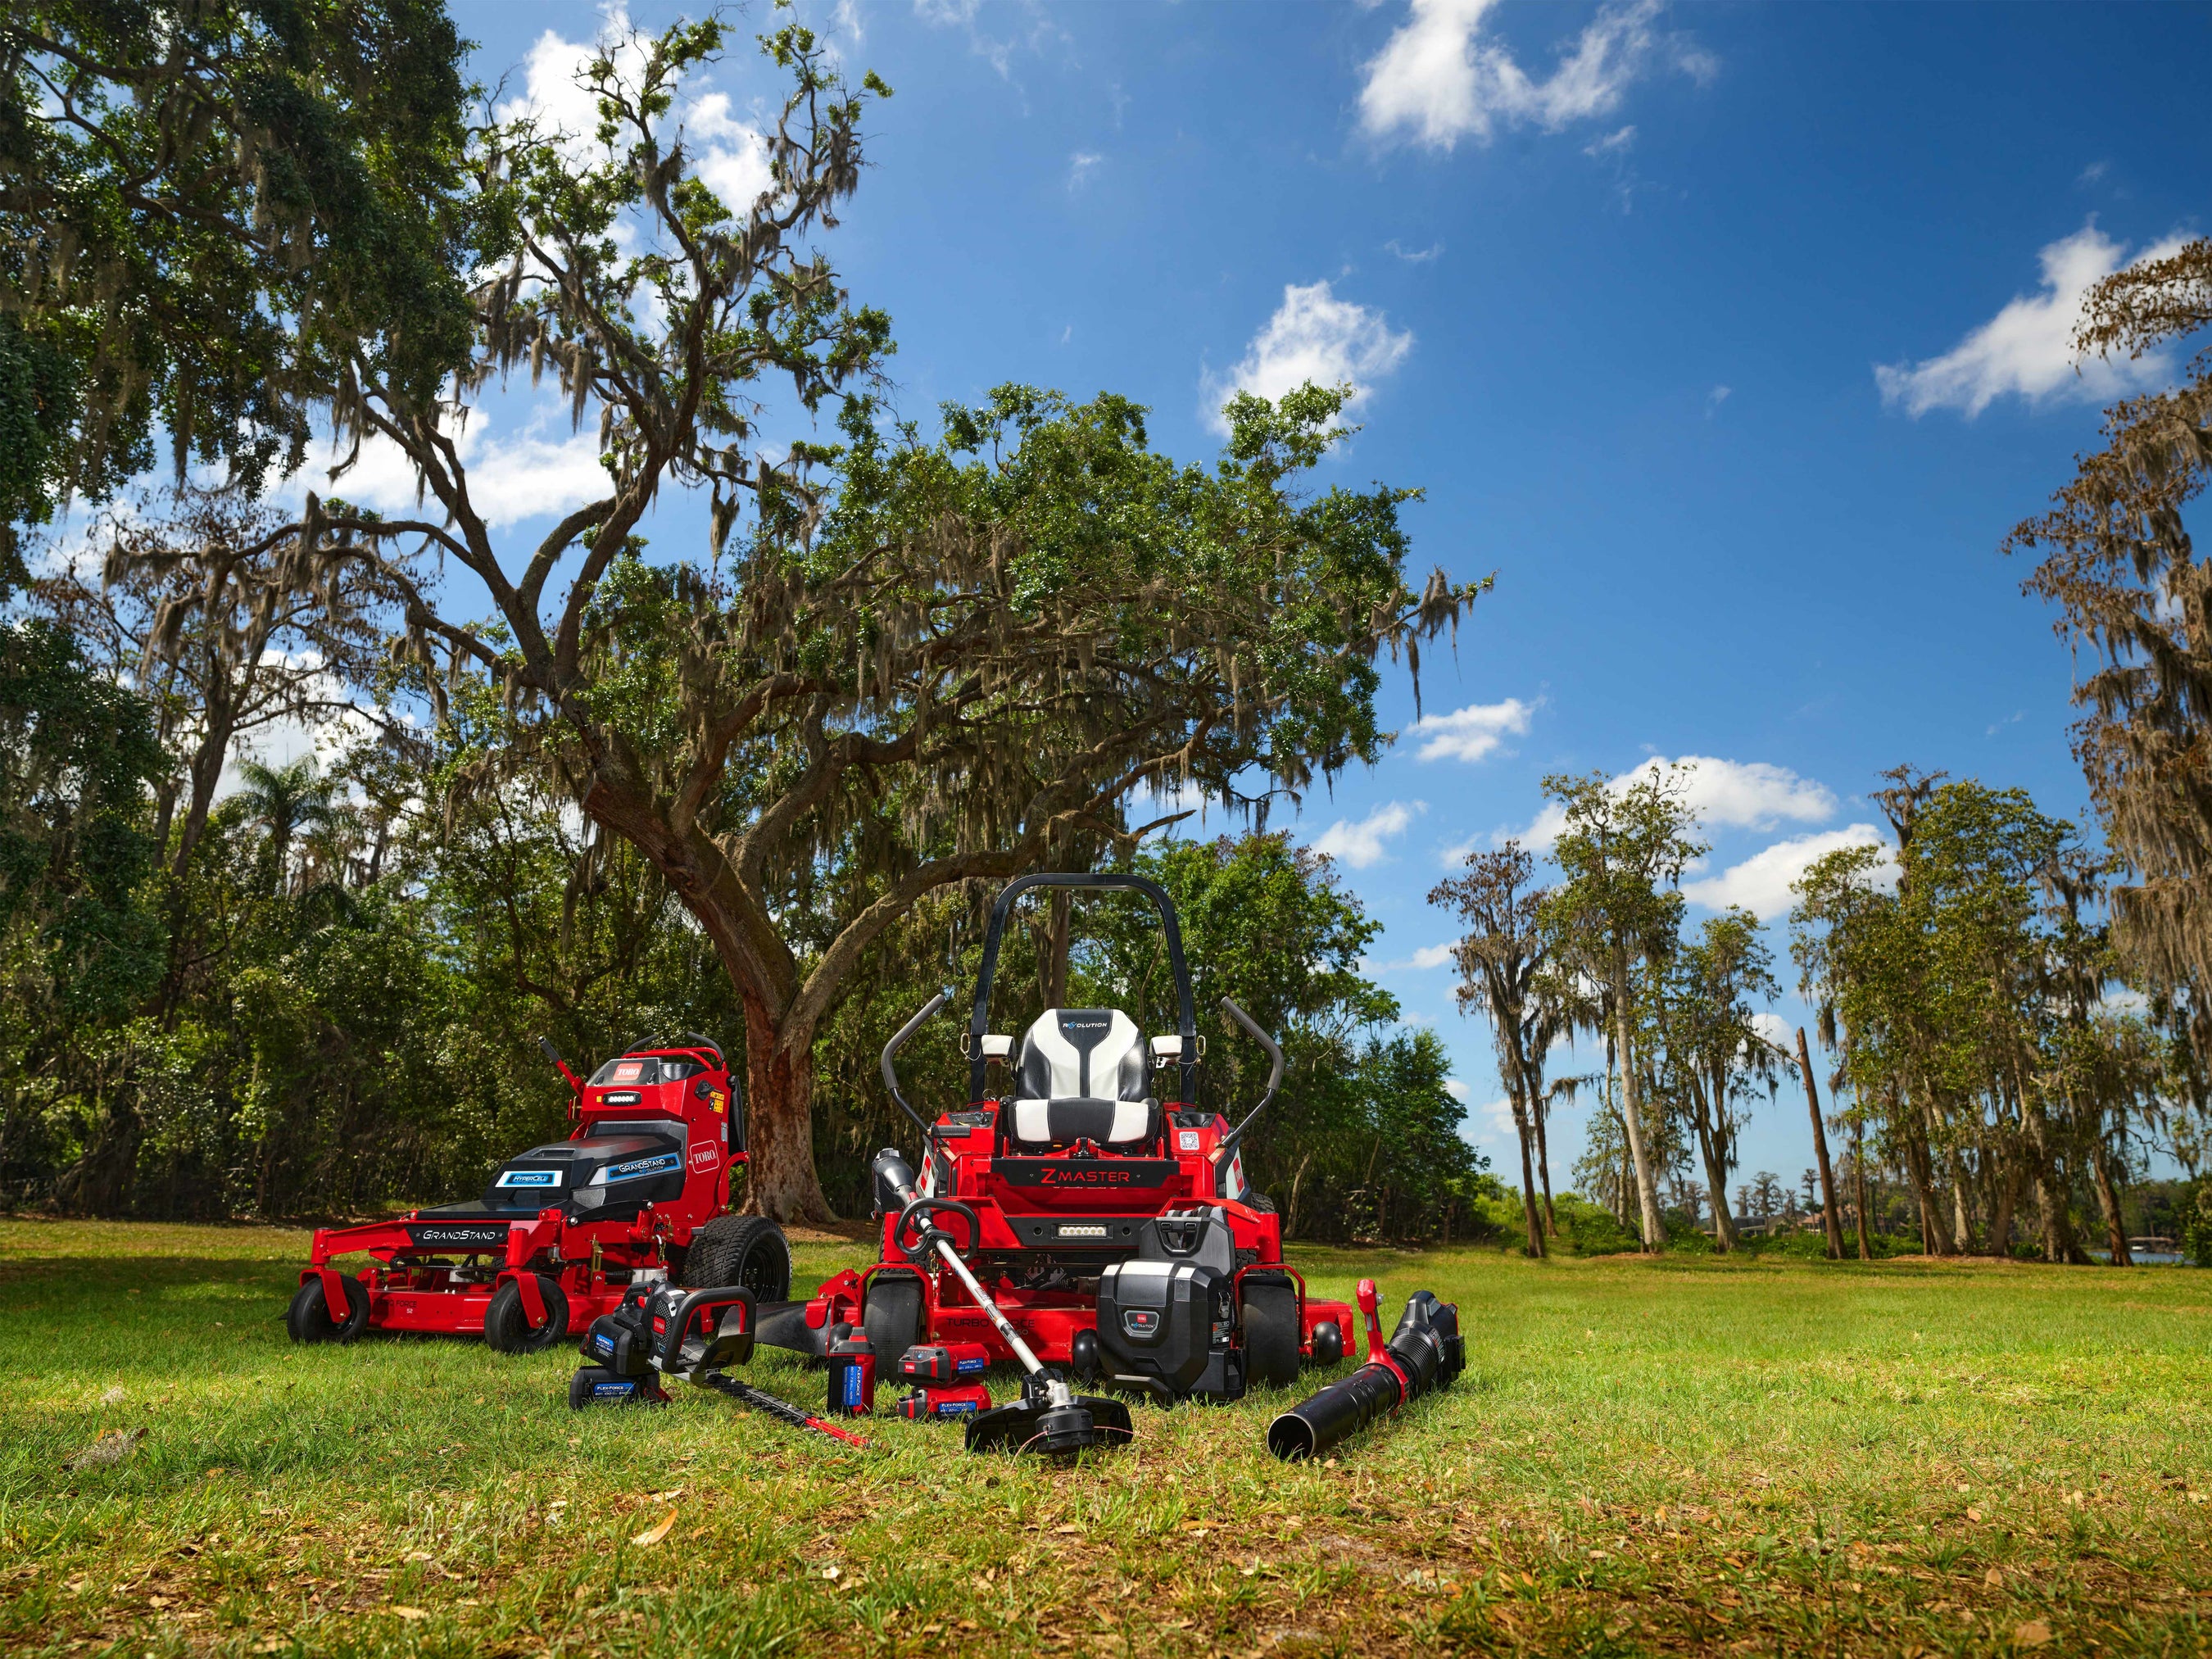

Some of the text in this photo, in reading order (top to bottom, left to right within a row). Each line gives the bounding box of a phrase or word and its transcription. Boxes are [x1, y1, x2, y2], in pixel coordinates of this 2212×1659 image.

[618, 1067, 640, 1076] TORO
[693, 1149, 717, 1164] TORO
[423, 1230, 496, 1240] GRANDSTAND
[946, 1317, 990, 1327] TURBO
